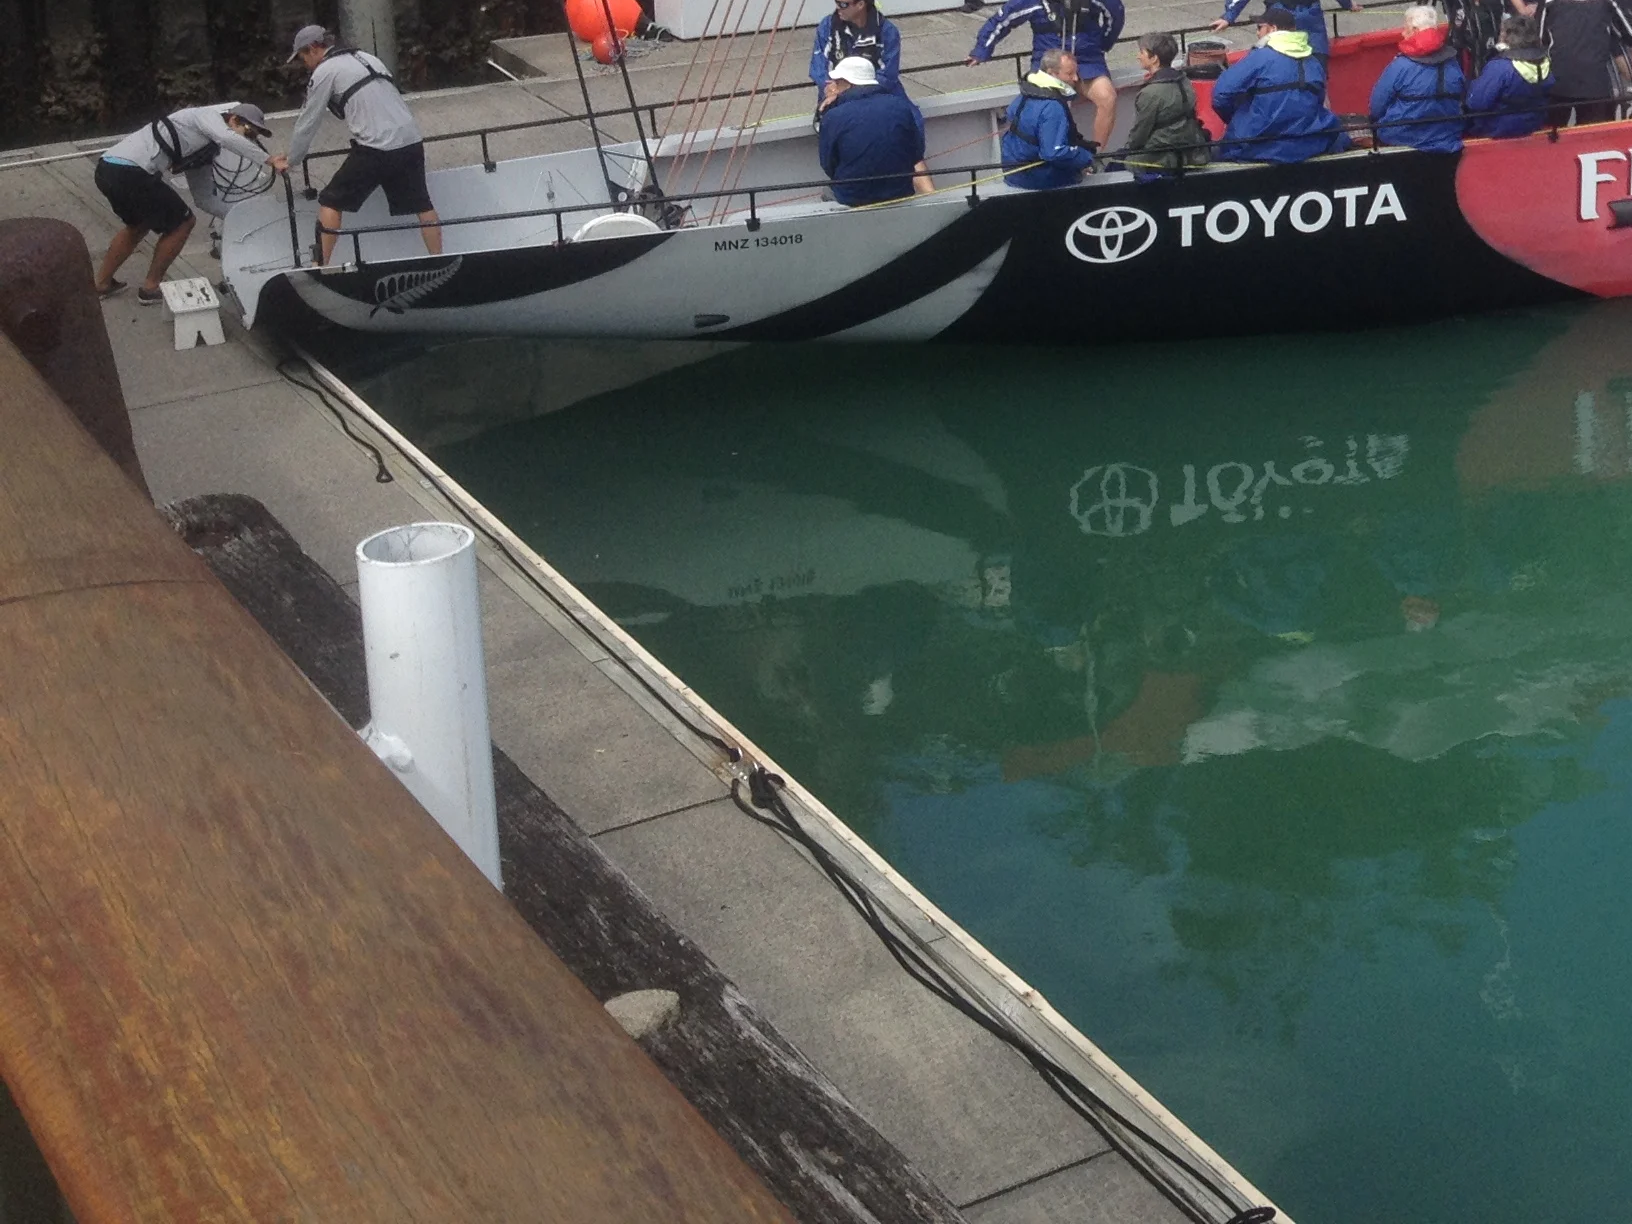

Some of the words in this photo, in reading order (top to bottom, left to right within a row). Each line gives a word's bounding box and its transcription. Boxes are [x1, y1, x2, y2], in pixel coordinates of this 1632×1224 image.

[1168, 183, 1407, 247] TOYOTA
[714, 238, 750, 252] MNZ
[755, 234, 803, 248] 134018
